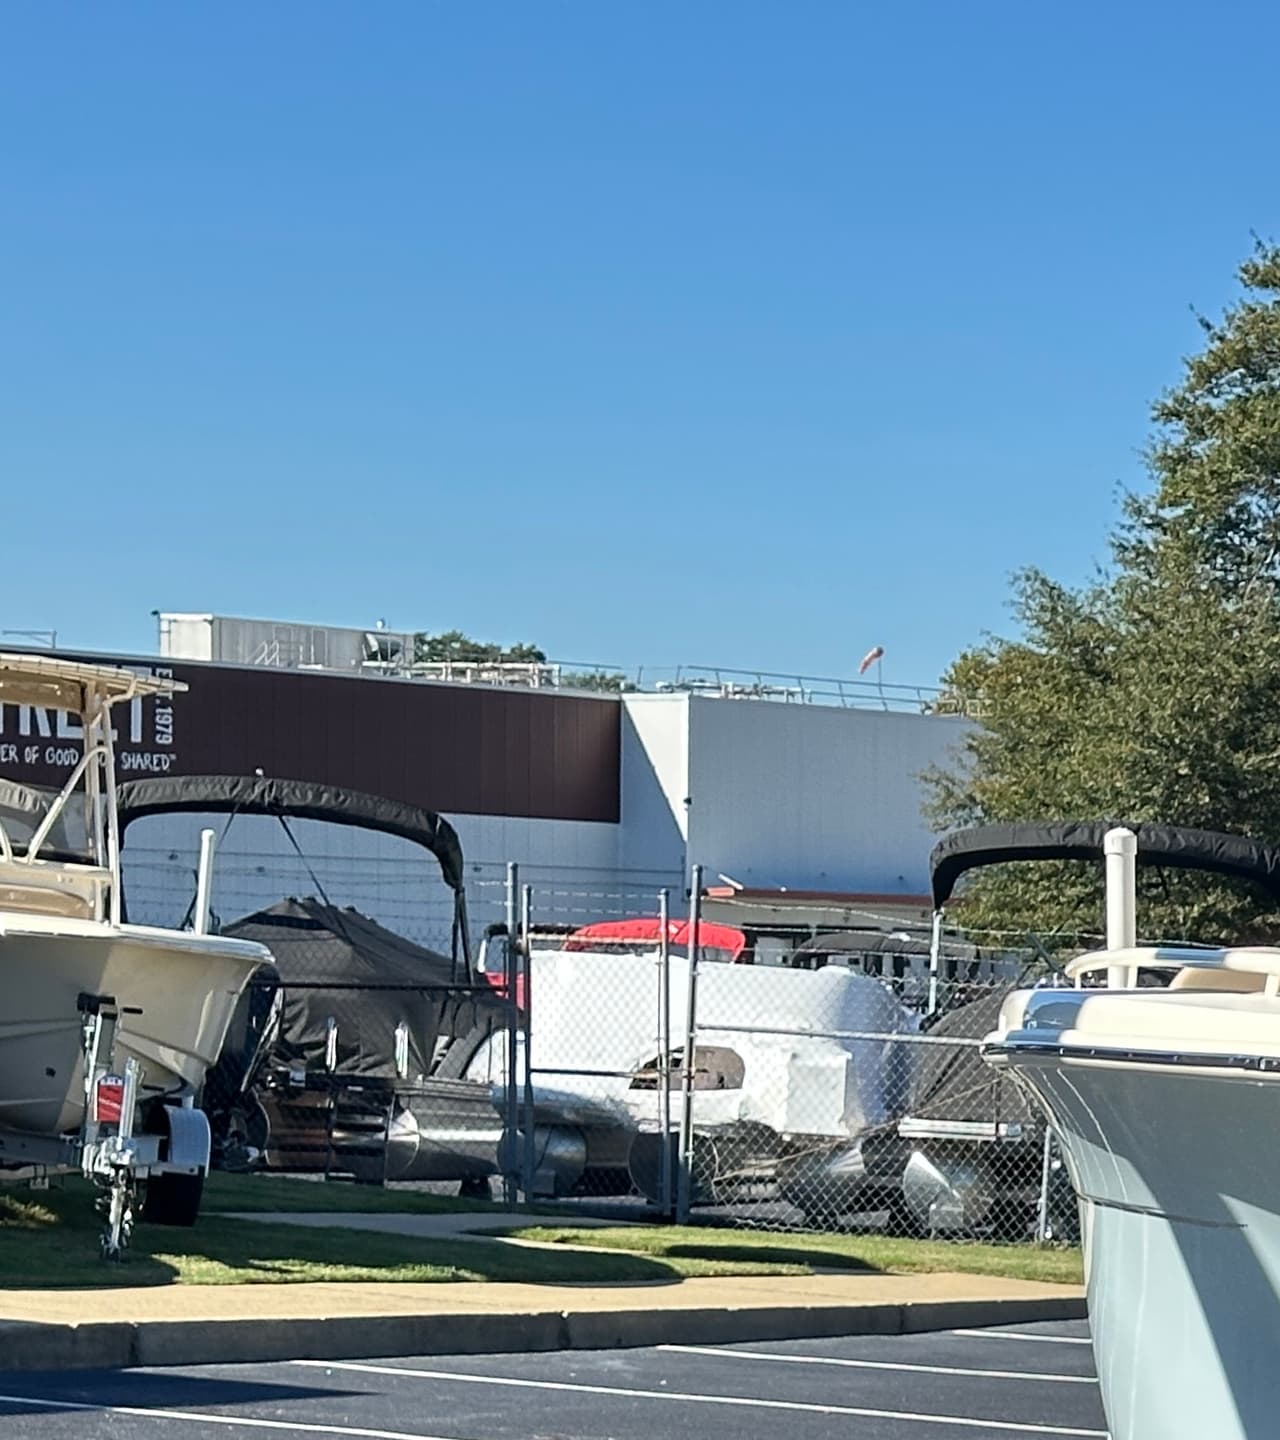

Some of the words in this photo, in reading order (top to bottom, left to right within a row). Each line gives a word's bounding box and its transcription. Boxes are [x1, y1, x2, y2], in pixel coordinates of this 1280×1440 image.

[156, 668, 173, 704] ET.
[156, 706, 173, 745] 1979
[24, 746, 40, 765] OF
[45, 746, 79, 767] GOOD
